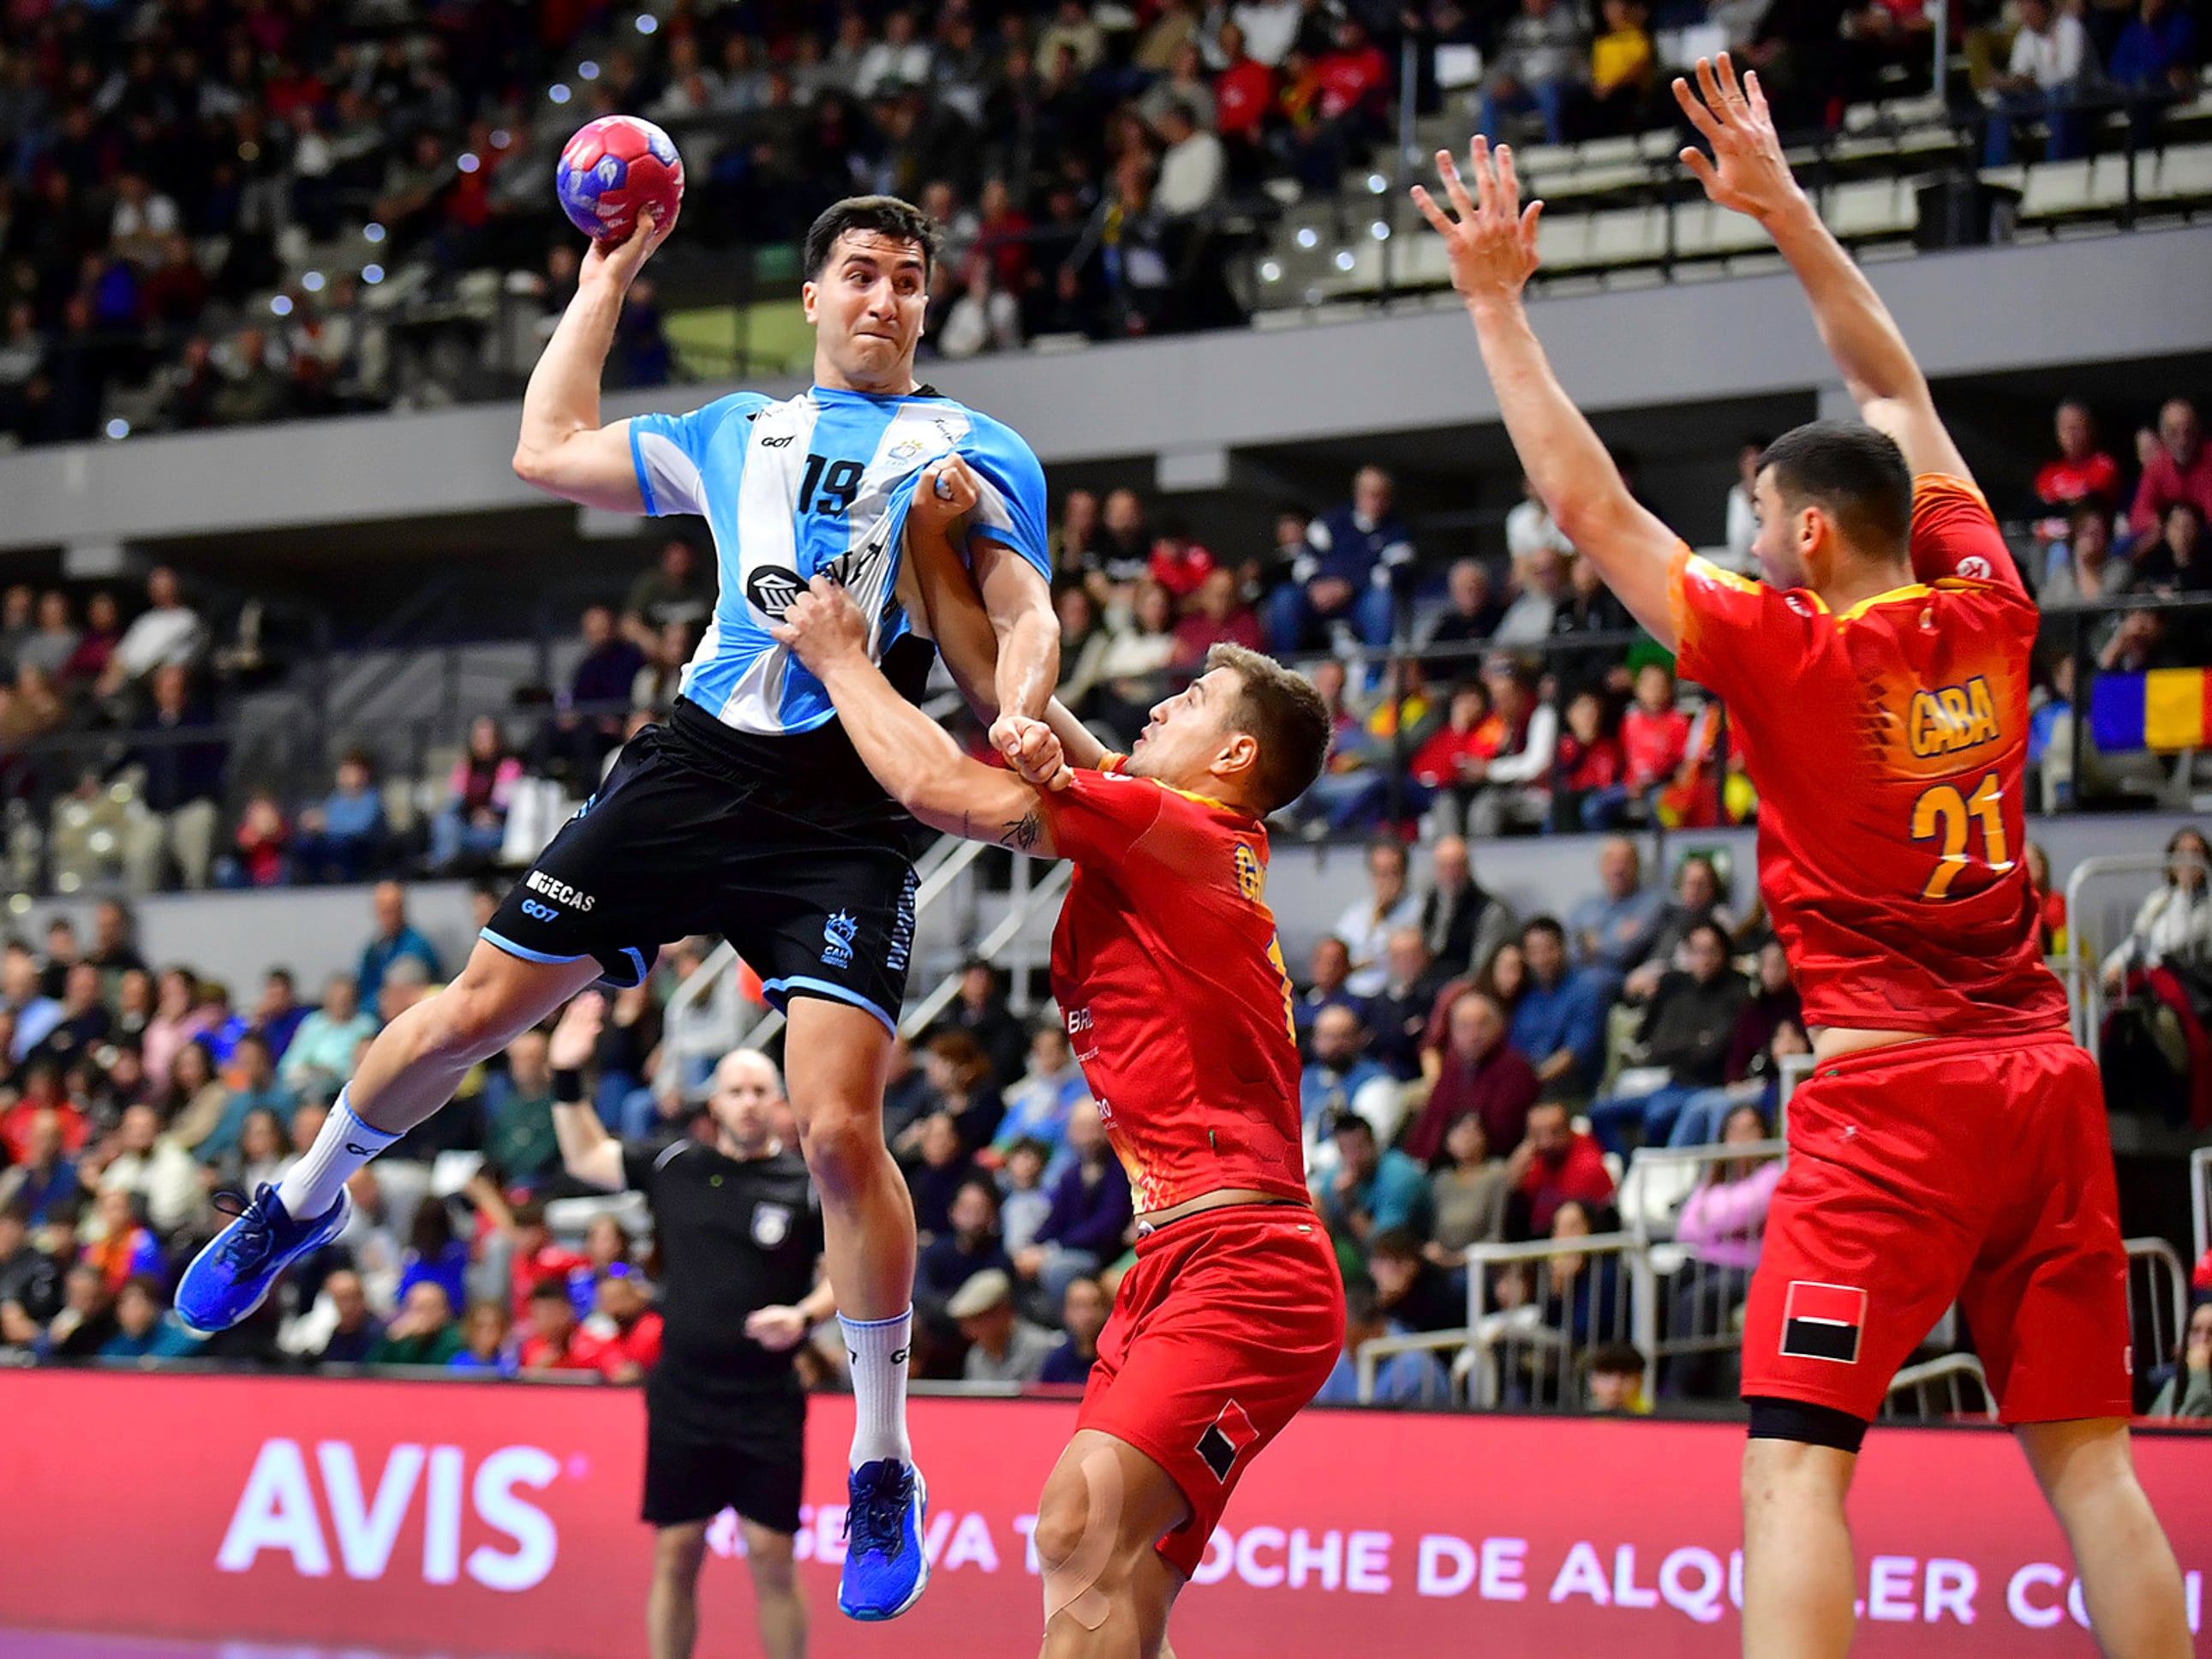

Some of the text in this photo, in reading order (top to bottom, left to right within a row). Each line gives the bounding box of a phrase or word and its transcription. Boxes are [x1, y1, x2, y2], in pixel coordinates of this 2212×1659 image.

[799, 453, 865, 518] 19
[1910, 674, 2000, 758] CABA
[1910, 769, 2015, 899] 21
[521, 898, 559, 923] GO7
[214, 1437, 562, 1592] AVIS
[1417, 1534, 1529, 1601] DE
